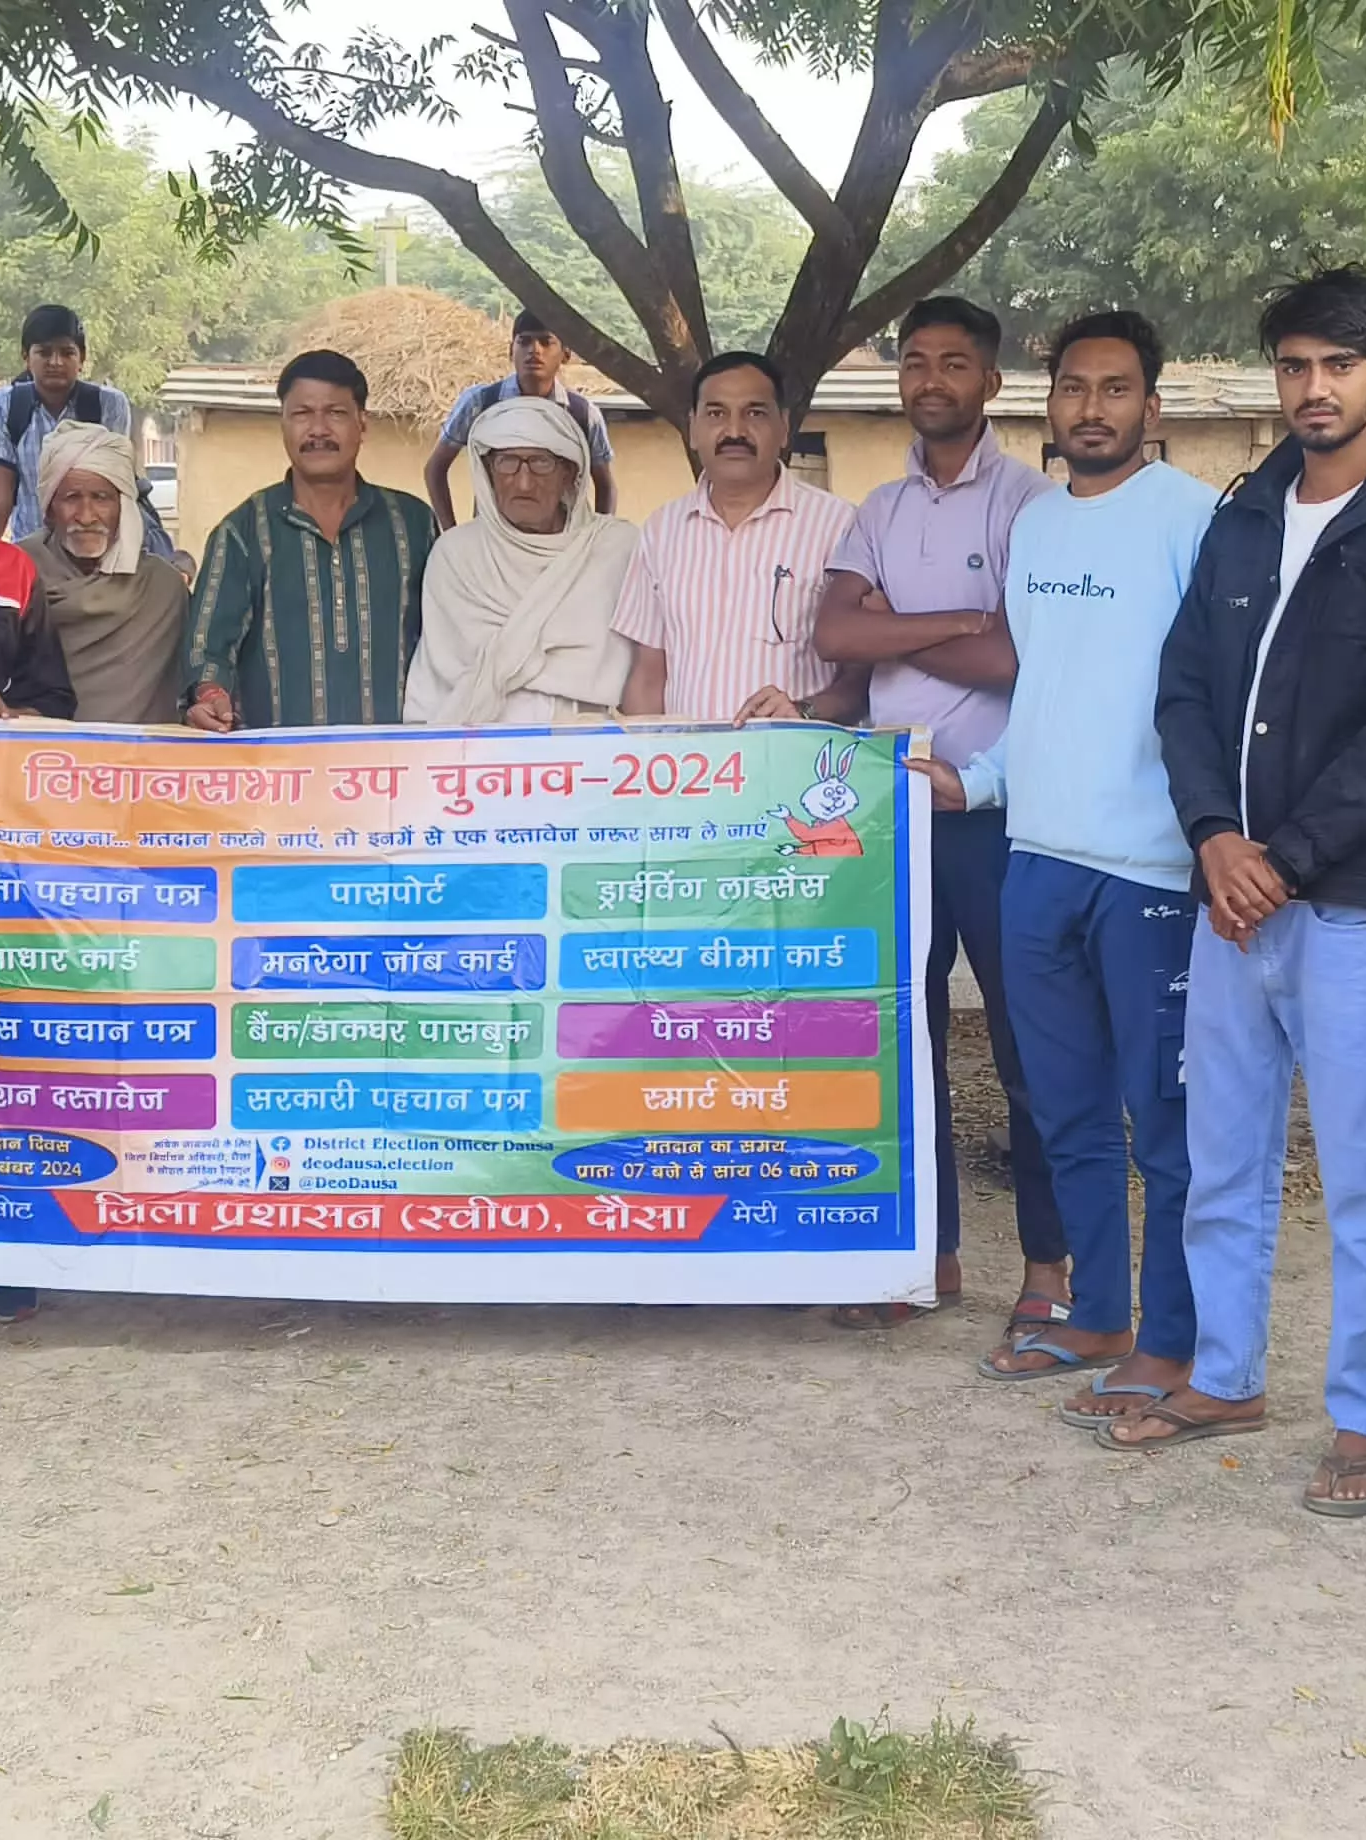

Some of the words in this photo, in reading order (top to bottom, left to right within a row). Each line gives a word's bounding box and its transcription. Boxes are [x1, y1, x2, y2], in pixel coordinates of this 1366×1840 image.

[23, 751, 312, 804] विधानसभा
[328, 766, 409, 801] उप
[138, 831, 210, 848] मतदान
[219, 829, 269, 848] करने
[334, 827, 360, 847] तो
[367, 824, 414, 847] इनमें
[424, 826, 445, 846] से
[453, 829, 487, 846] एक
[495, 823, 580, 844] दस्तावेज
[587, 827, 642, 843] जरूर
[648, 826, 691, 842] साथ
[699, 820, 718, 840] ले
[725, 816, 769, 839] जाएं
[35, 879, 144, 906] पहचान
[153, 883, 206, 907] पत्र
[330, 873, 448, 905] पासपोर्ट
[715, 864, 830, 901] लाइसेंस
[79, 940, 140, 973] कार्ड
[259, 944, 373, 975] मनरेगा
[382, 942, 448, 974] जॉब
[457, 940, 518, 973] कार्ड
[582, 945, 689, 971] स्वास्थ्य
[699, 936, 775, 968] बीमा
[786, 936, 846, 968] कार्ड
[30, 1019, 134, 1045] पहचान
[143, 1020, 197, 1043] पत्र
[418, 1020, 531, 1054] पासबुक
[651, 1009, 705, 1041] पैन
[713, 1010, 775, 1042] कार्ड
[49, 1081, 169, 1111] दस्तावेज
[246, 1079, 360, 1112] सरकारी
[370, 1088, 473, 1113] पहचान
[483, 1088, 531, 1112] पत्र
[641, 1077, 718, 1110] स्मार्ट
[729, 1078, 789, 1110] कार्ड
[27, 1134, 72, 1152] दिवस
[303, 1137, 366, 1151] District
[372, 1137, 439, 1151] Election
[444, 1138, 499, 1151] Officer
[503, 1139, 554, 1152] Dausa
[643, 1139, 704, 1153] मतदान
[708, 1140, 733, 1153] का
[738, 1140, 787, 1153] समय
[41, 1160, 83, 1177] 2024
[302, 1157, 454, 1171] deodausa.election
[622, 1162, 645, 1178] 07
[650, 1161, 683, 1179] बजे
[688, 1161, 707, 1179] से
[759, 1162, 783, 1178] 06
[788, 1160, 821, 1178] बजे
[826, 1163, 859, 1178] तक
[298, 1177, 398, 1190] @DeoDausa
[94, 1191, 201, 1226] जिला
[211, 1200, 385, 1232] प्रशासन
[400, 1195, 563, 1233] (स्वीप),
[584, 1194, 691, 1231] दौसा
[732, 1199, 778, 1225] मेरी
[797, 1204, 880, 1226] ताकत
